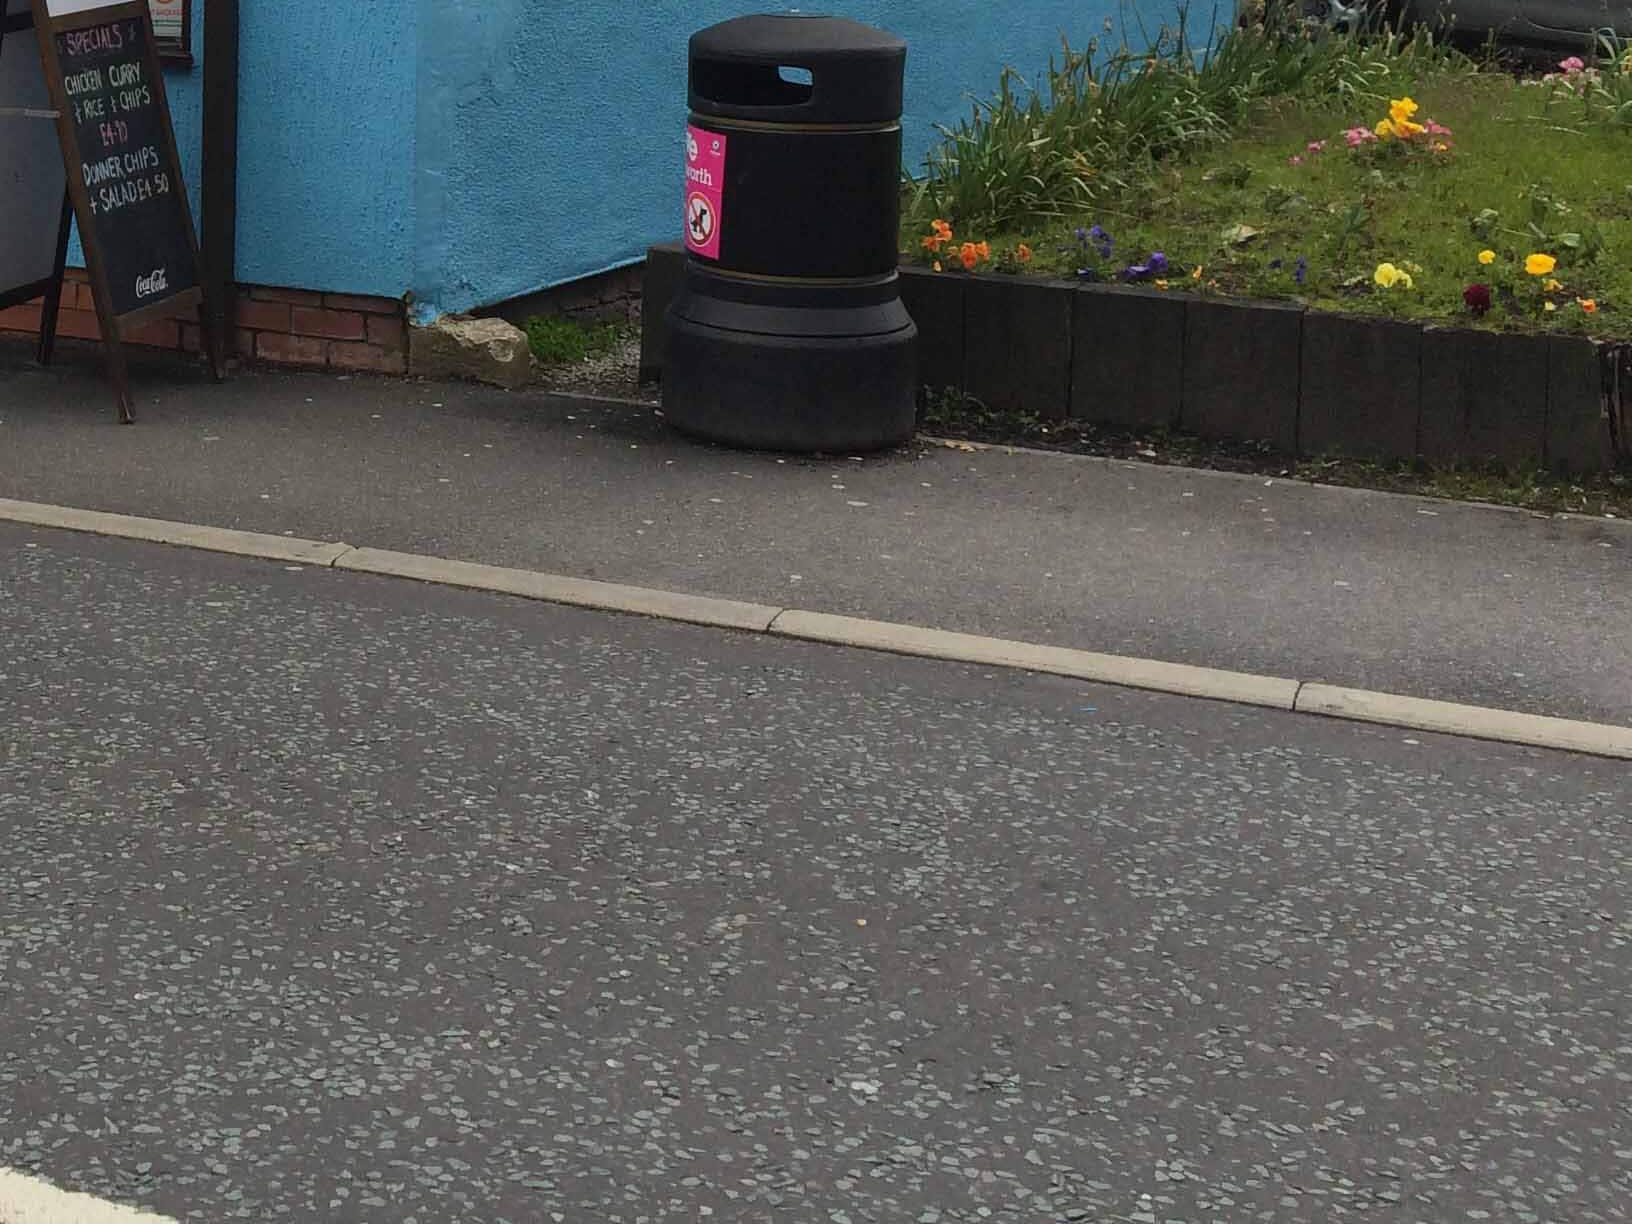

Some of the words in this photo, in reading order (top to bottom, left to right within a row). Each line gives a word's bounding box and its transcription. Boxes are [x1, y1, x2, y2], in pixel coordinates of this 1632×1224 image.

[65, 24, 122, 56] SPECIALS
[65, 68, 103, 96] CHICKEN
[109, 61, 141, 87] CURRY
[83, 98, 105, 120] RICE
[119, 85, 151, 112] CHIPS
[82, 156, 121, 187] DONNER
[124, 146, 159, 173] CHIPS
[99, 181, 137, 212] SALAD
